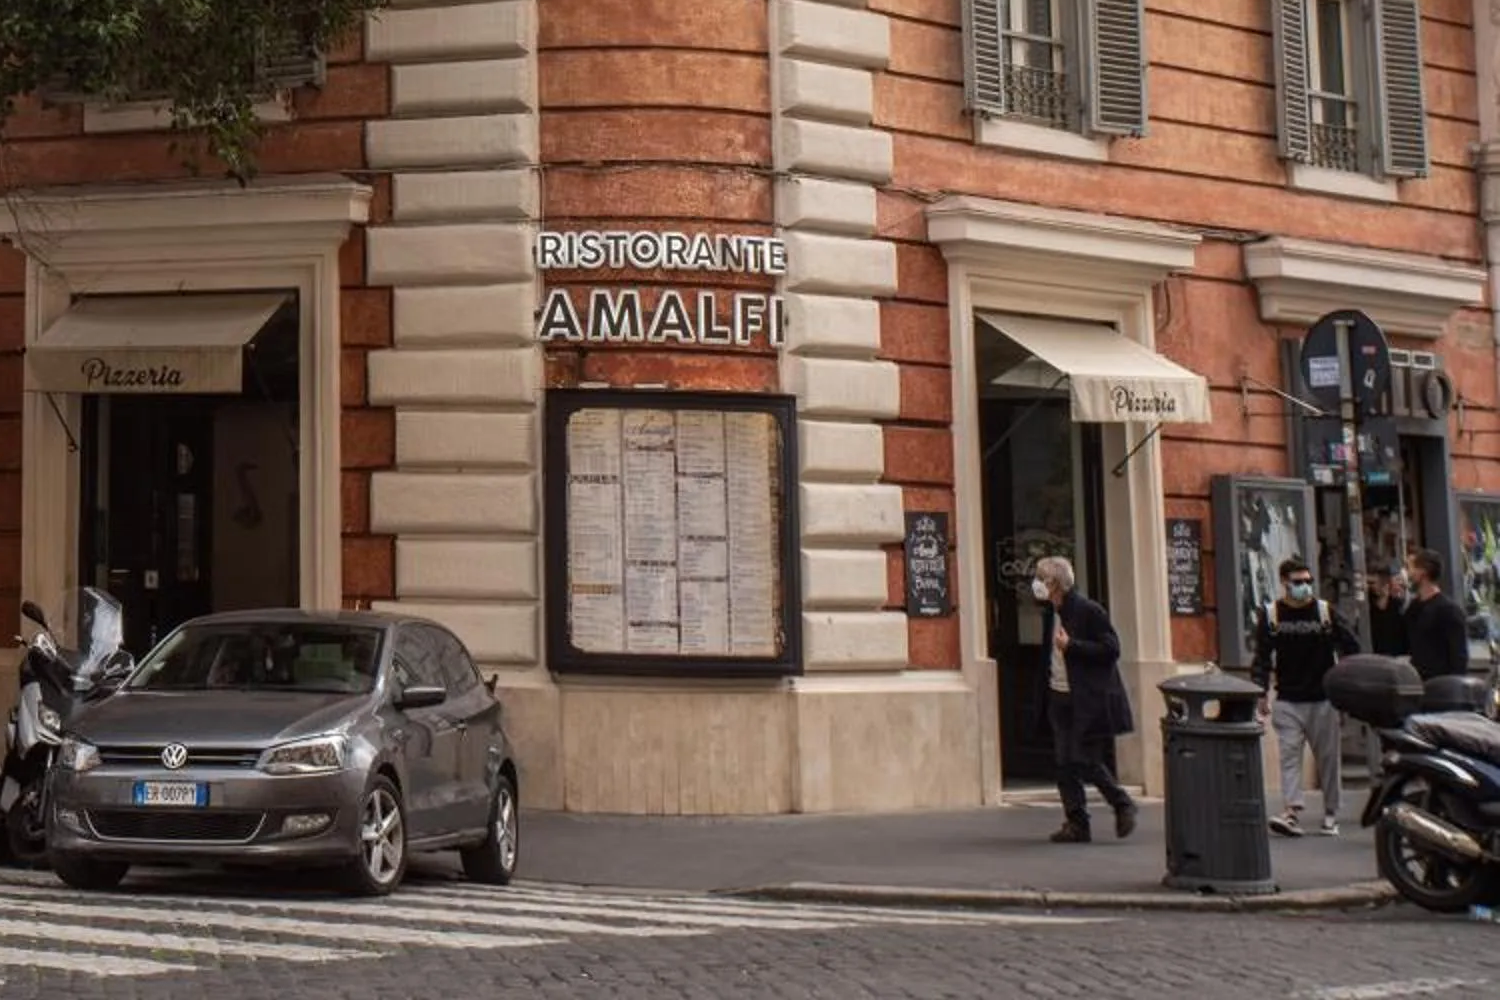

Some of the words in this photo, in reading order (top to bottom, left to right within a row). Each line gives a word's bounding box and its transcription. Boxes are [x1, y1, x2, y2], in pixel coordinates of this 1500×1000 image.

[538, 231, 787, 274] RISTORANTE
[538, 288, 786, 347] AMALFI
[81, 357, 183, 389] Pizzeria
